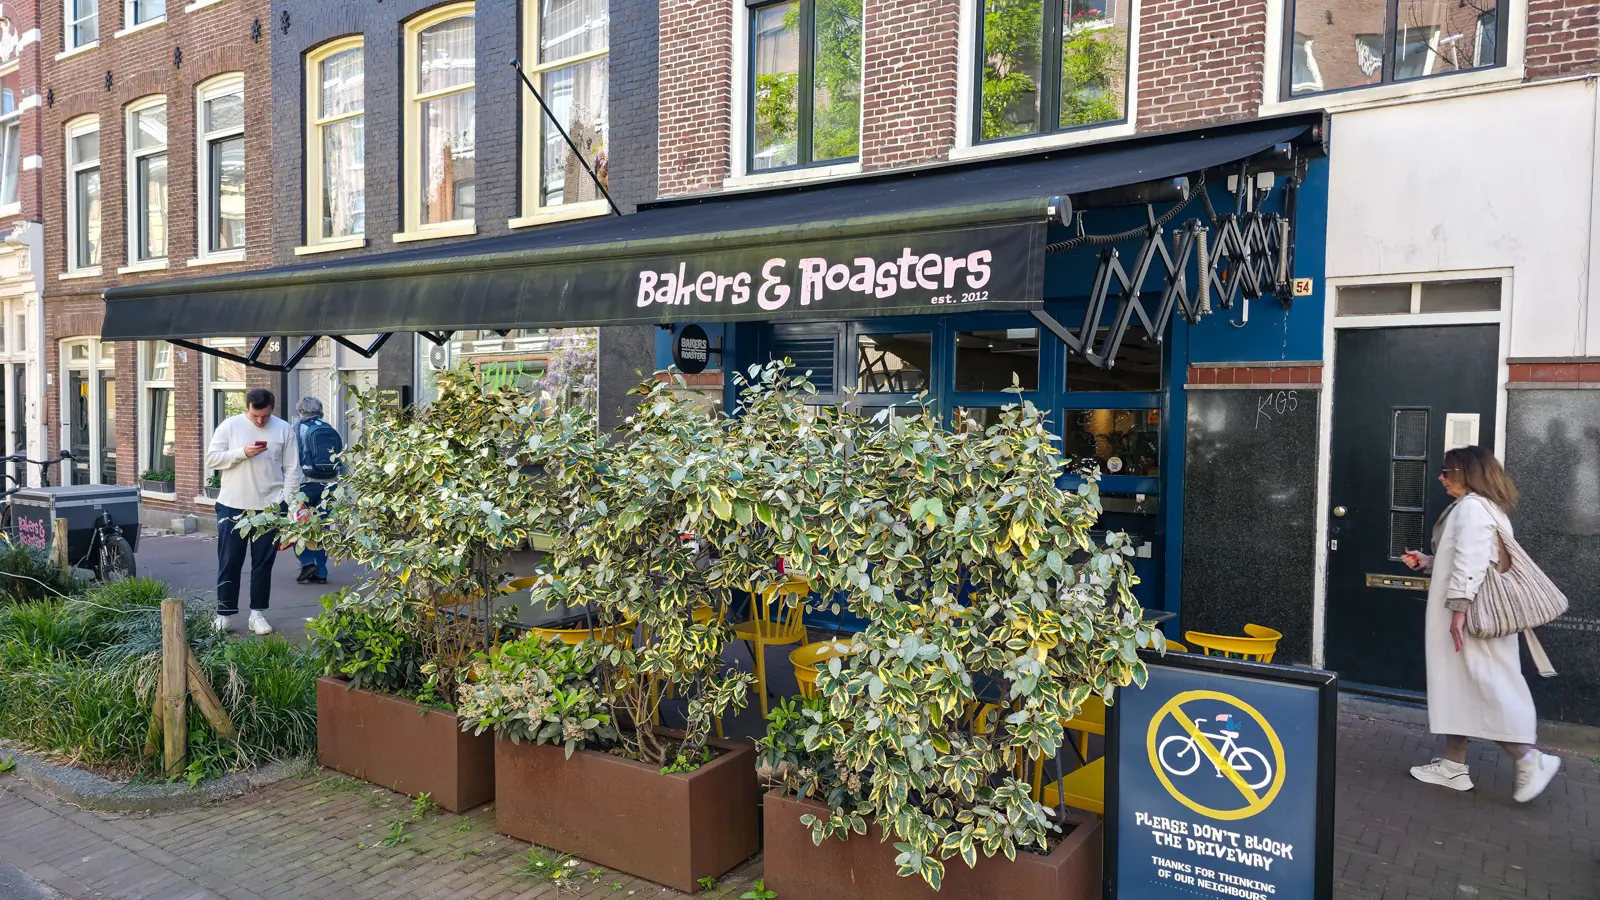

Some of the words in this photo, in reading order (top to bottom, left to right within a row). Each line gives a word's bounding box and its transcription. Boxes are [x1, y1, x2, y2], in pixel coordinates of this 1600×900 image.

[636, 261, 751, 308] Bakers
[757, 257, 791, 311] &
[798, 247, 992, 306] Roasters
[1296, 281, 1310, 293] 54
[930, 294, 958, 305] est.
[961, 291, 989, 303] 2012
[269, 341, 280, 352] 56
[681, 337, 707, 349] BAKERS
[681, 351, 707, 360] ROASTERS
[1135, 811, 1188, 835] PLEASE
[1192, 823, 1240, 848] DON'T
[1244, 835, 1294, 860] BLOCK
[1151, 831, 1182, 849] THE
[1186, 837, 1274, 871] DRIVEWAY
[1151, 855, 1192, 873] THANKS
[1194, 866, 1215, 880] FOR
[1218, 872, 1276, 894] THINKING
[1157, 869, 1172, 879] OF
[1174, 873, 1195, 886] OUR
[1197, 878, 1267, 900] NEIGHBOURS
